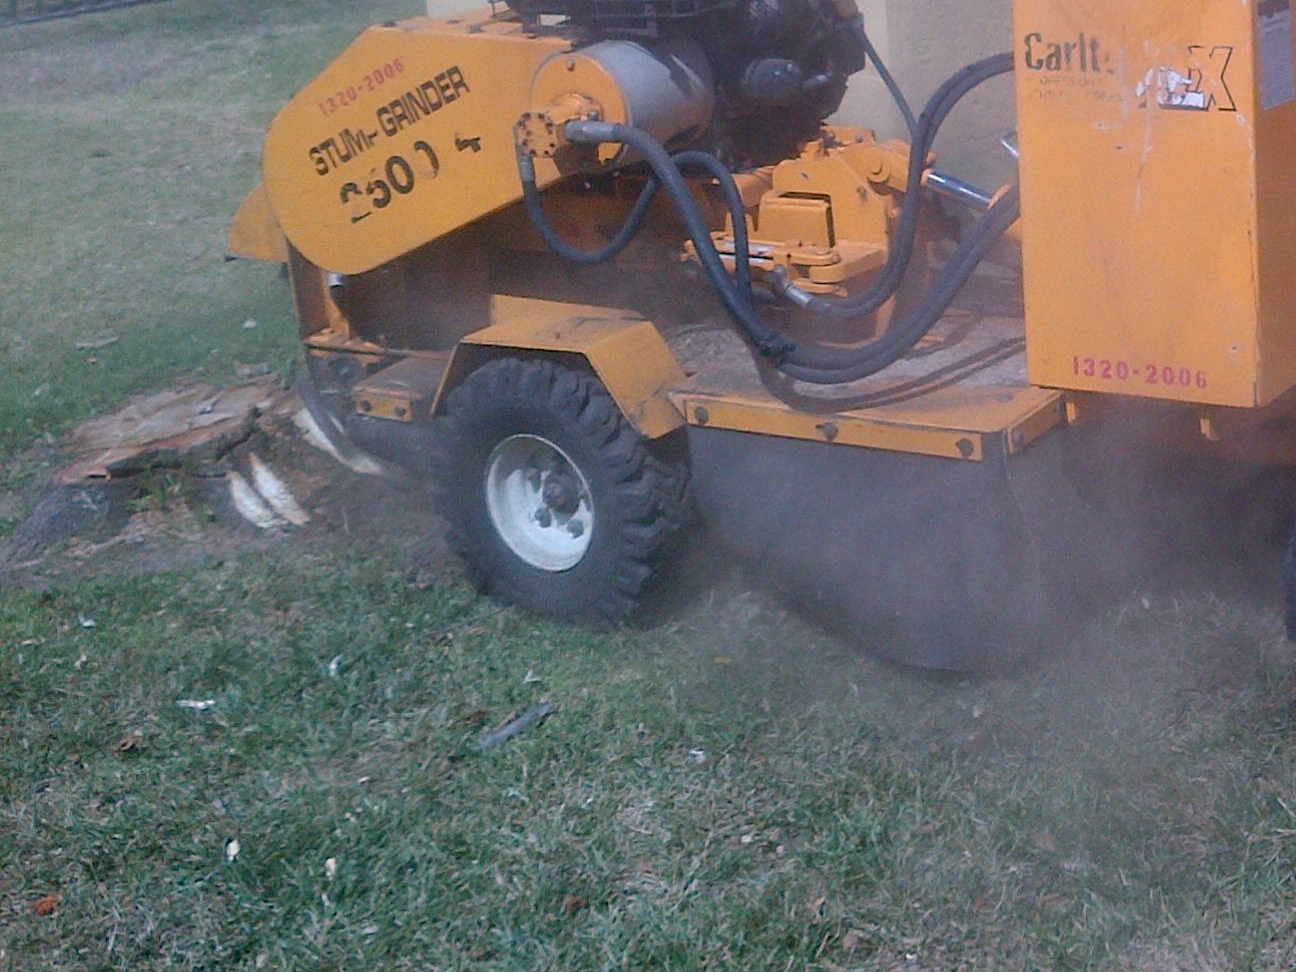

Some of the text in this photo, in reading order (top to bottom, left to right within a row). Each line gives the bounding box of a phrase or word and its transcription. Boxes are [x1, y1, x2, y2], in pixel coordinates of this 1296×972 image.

[1024, 32, 1114, 75] Carlt
[318, 58, 405, 116] 1320-2006
[376, 66, 470, 137] GRINDER
[1073, 355, 1207, 389] 1320-2006
